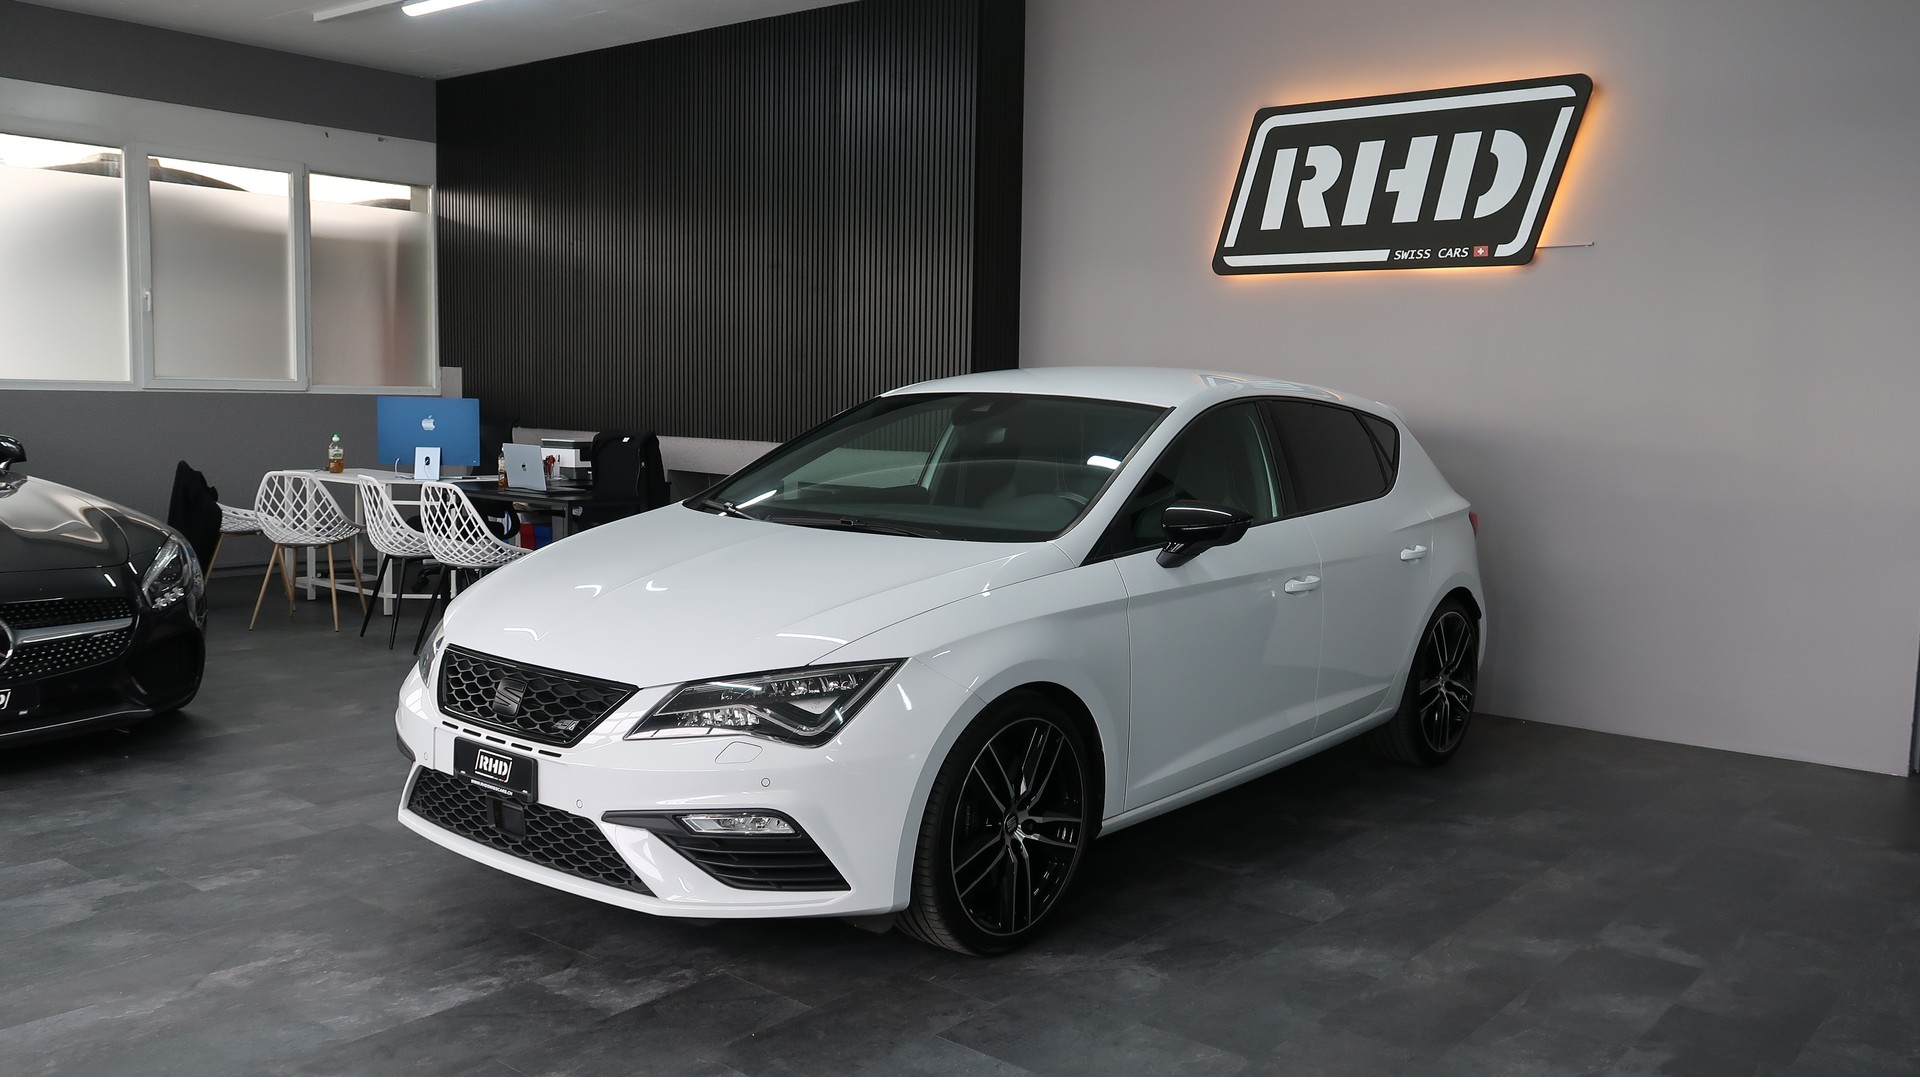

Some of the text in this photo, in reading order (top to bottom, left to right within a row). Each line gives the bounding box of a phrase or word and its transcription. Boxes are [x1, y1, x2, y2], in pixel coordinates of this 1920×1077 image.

[1259, 129, 1529, 231] RHD
[1393, 246, 1470, 261] SWISS CARS
[478, 754, 509, 777] RHD
